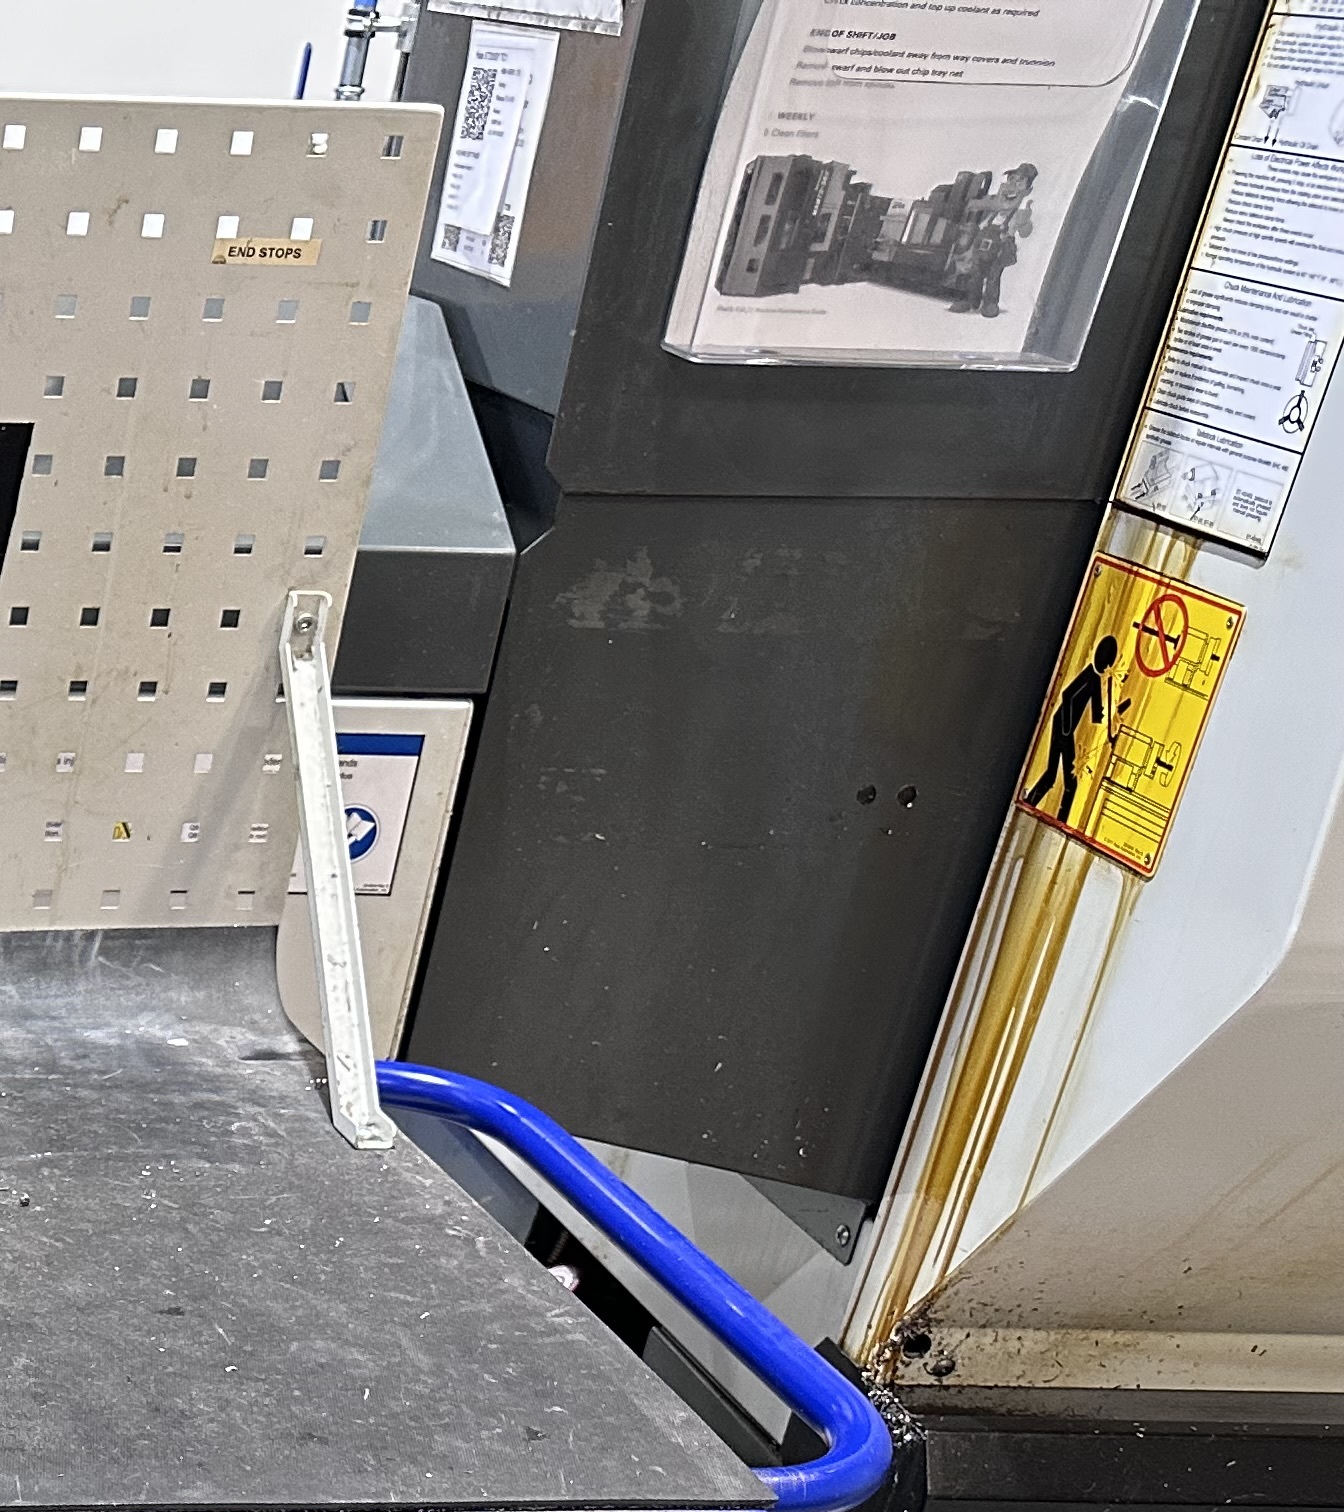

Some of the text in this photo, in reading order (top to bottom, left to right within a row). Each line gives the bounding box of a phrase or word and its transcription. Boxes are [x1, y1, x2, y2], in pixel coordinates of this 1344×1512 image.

[957, 5, 990, 14] coolant
[1003, 9, 1040, 17] required
[832, 30, 845, 38] OF
[931, 52, 951, 60] from
[953, 54, 971, 63] way
[972, 56, 1000, 64] covers
[1001, 57, 1019, 65] and
[856, 65, 872, 73] and
[777, 112, 816, 121] WEEKLY
[228, 246, 302, 259] END STOPS
